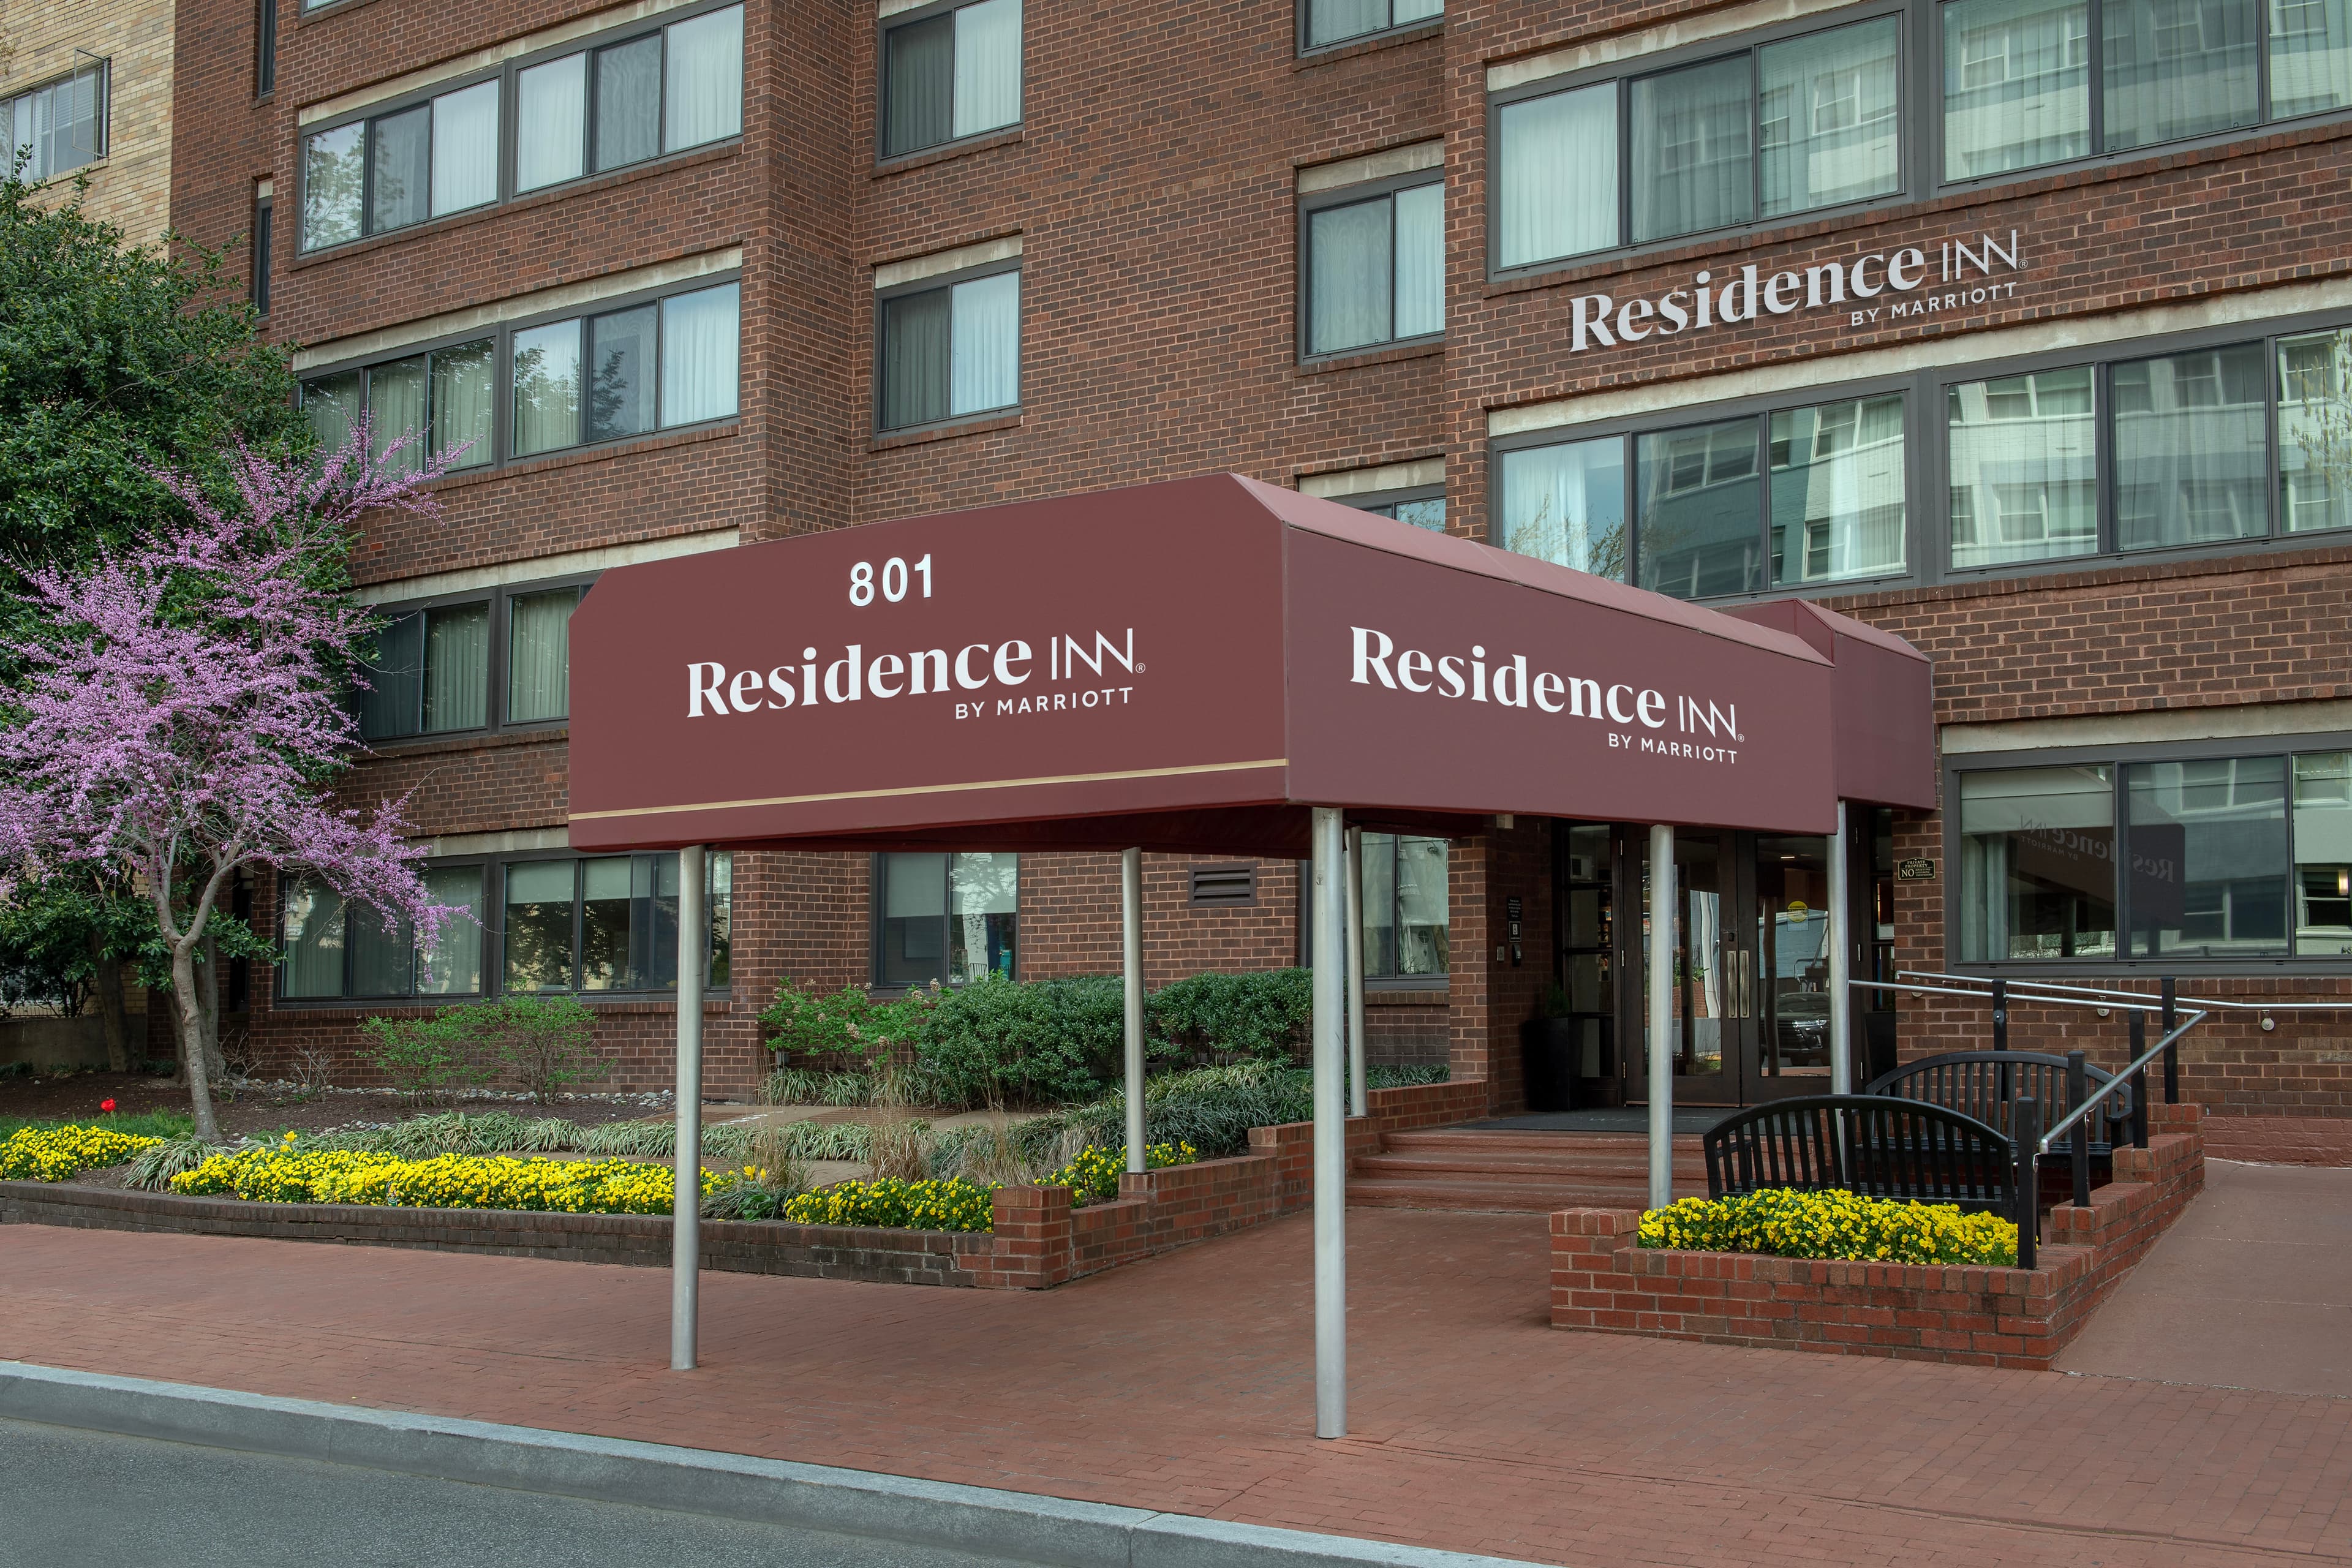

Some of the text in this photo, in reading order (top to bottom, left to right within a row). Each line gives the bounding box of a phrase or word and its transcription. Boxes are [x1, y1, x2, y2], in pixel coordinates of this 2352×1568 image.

[1569, 248, 1924, 352] Residence
[1851, 282, 2018, 326] BY MARRIOTT
[849, 553, 932, 607] 801
[687, 640, 1032, 718] Residence
[1349, 626, 1666, 728] Residence
[956, 687, 1133, 720] BY MARRIOTT
[1608, 733, 1738, 764] BY MARRIOTT
[1901, 869, 1915, 877] NO
